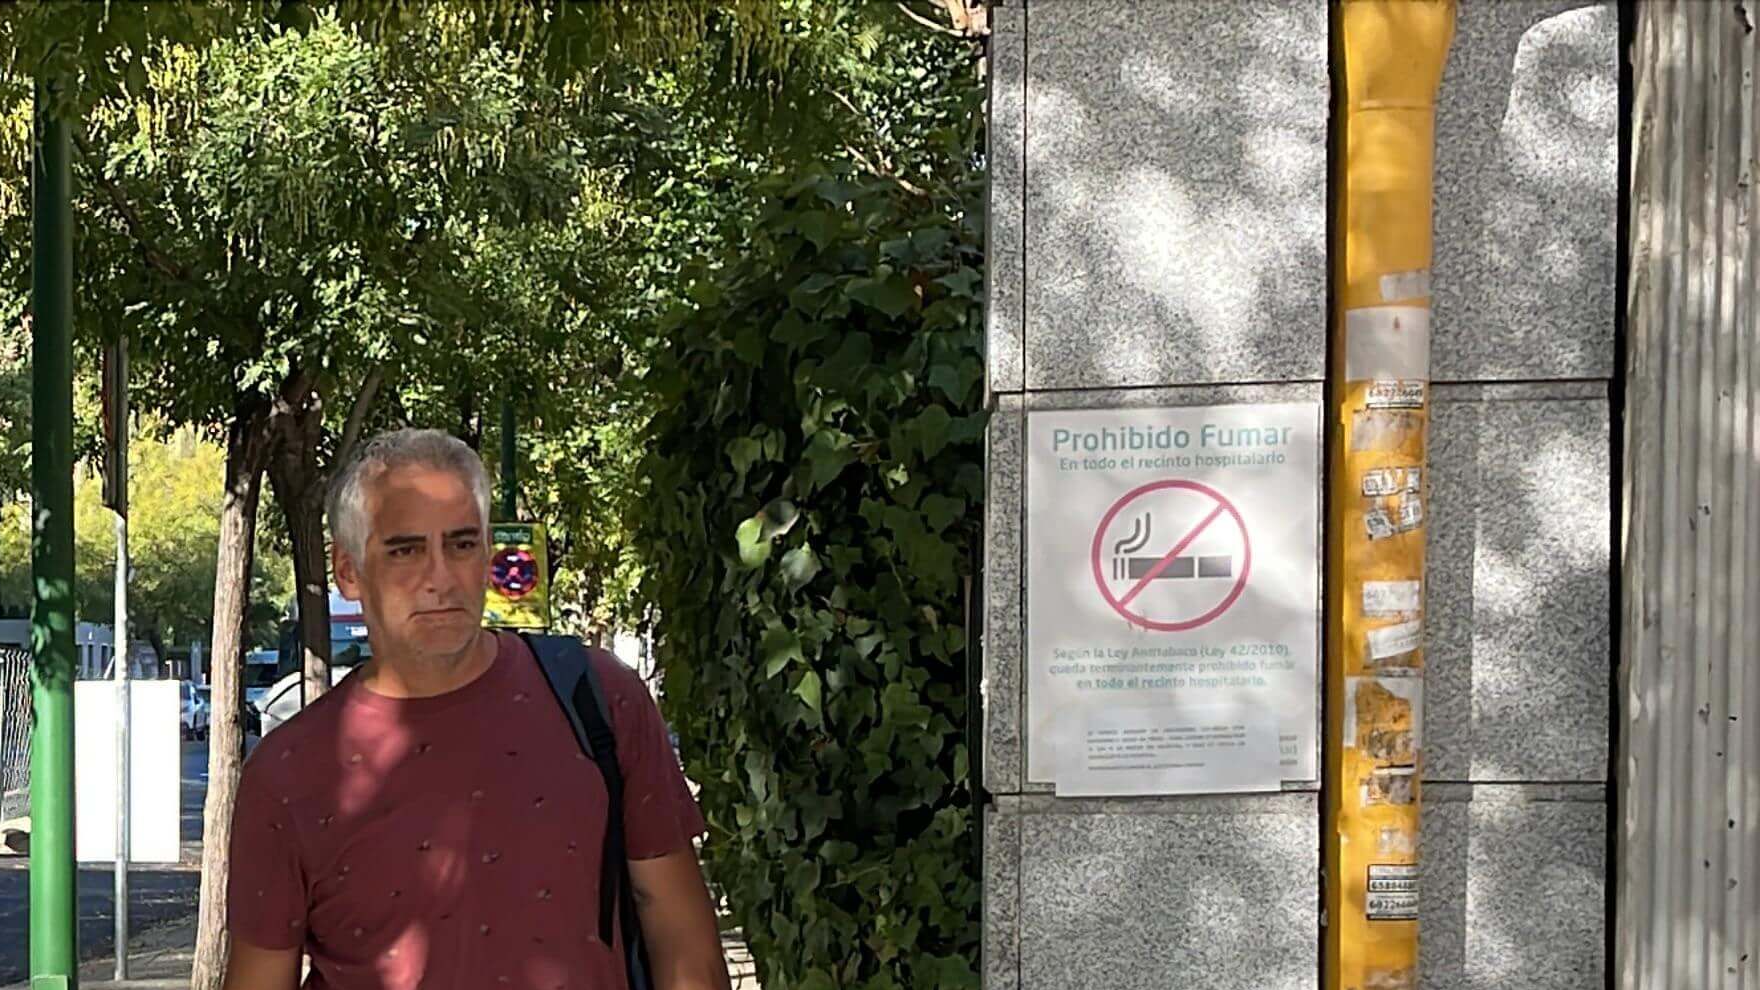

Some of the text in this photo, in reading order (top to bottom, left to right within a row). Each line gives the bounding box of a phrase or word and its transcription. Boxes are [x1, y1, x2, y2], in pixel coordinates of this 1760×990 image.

[1052, 424, 1291, 452] Prohibido Fumar
[1059, 451, 1285, 471] En todo el recinto hospitalario
[1094, 647, 1104, 659] la
[1107, 648, 1128, 660] Ley
[1076, 680, 1092, 688] en
[1096, 677, 1124, 688] todo
[1127, 677, 1139, 687] el
[1142, 676, 1186, 688] recinto
